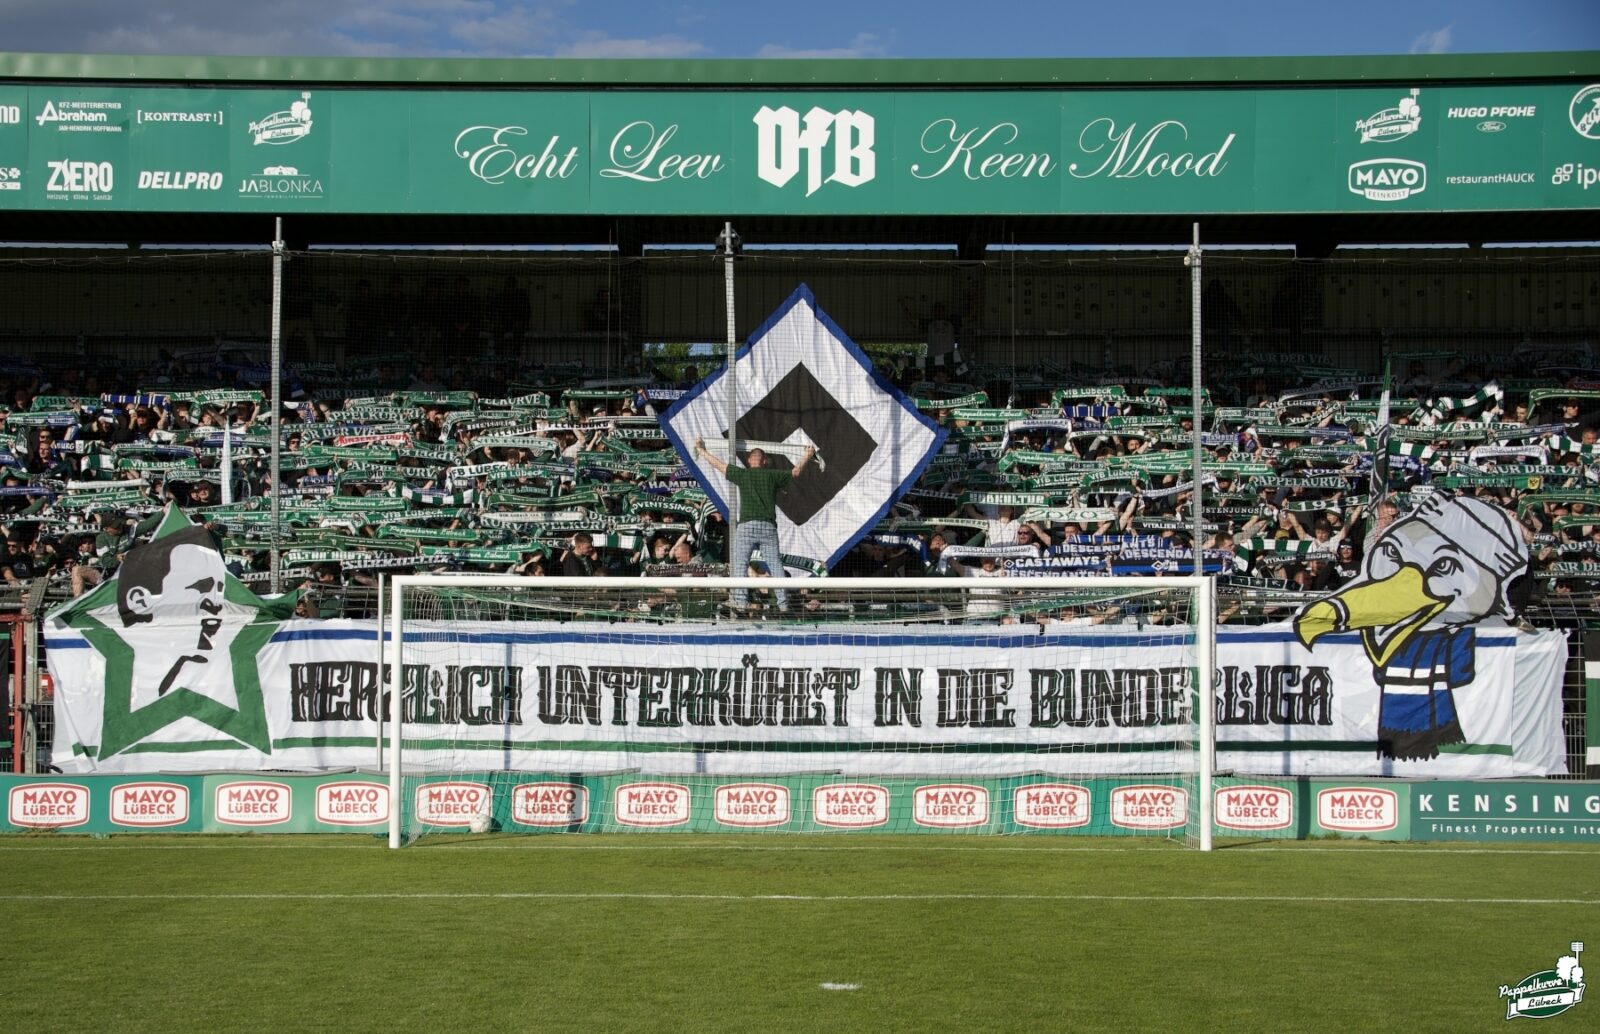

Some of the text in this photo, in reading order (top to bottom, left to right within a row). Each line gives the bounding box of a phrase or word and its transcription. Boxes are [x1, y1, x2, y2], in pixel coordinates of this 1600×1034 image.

[36, 100, 108, 126] Abraham
[1448, 106, 1536, 118] HUGO PFOHE
[454, 126, 578, 184] Echt
[753, 106, 876, 198] VfB
[911, 118, 1236, 180] Keen Mood
[47, 158, 113, 192] ZIERO
[138, 171, 222, 190] DELLPRO
[1356, 168, 1419, 186] MAYO
[1446, 173, 1535, 184] restaurantHAUCK
[1578, 164, 1600, 190] ip
[239, 180, 323, 192] JABLONKA
[1368, 190, 1406, 199] FEINKOST
[1140, 415, 1172, 423] Lübeck
[152, 459, 186, 467] Lübeck
[1524, 464, 1554, 474] DER
[490, 469, 543, 480] VfB Lübeck
[1089, 468, 1140, 480] VfB Lübeck
[650, 480, 700, 489] HAMBU
[1254, 476, 1346, 488] PAPPELKURVE
[382, 509, 442, 520] VfB Lübeck
[1015, 556, 1100, 568] CASTAWAYS
[290, 653, 1334, 728] HERZLICH UNTERKÜHLT IN DIE BUNDESLIGA
[23, 790, 77, 804] MAYO
[124, 790, 176, 803] MAYO
[228, 789, 279, 802] MAYO
[328, 789, 379, 802] MAYO
[428, 789, 479, 802] MAYO
[525, 790, 576, 803] MAYO
[628, 790, 678, 804] MAYO
[728, 790, 777, 804] MAYO
[826, 791, 876, 804] MAYO
[926, 791, 976, 805] MAYO
[1026, 792, 1078, 805] MAYO
[1123, 792, 1174, 806] MAYO
[1227, 793, 1279, 806] MAYO
[1331, 794, 1384, 808] MAYO
[23, 805, 76, 815] LÜBECK
[124, 804, 175, 814] LÜBECK
[227, 802, 278, 813] LÜBECK
[328, 802, 378, 813] LÜBECK
[428, 803, 479, 814] LÜBECK
[524, 804, 576, 814] LÜBECK
[628, 804, 677, 815] LÜBECK
[727, 804, 776, 815] LÜBECK
[826, 804, 876, 816] LÜBECK
[925, 805, 975, 816] LÜBECK
[1026, 805, 1076, 816] LÜBECK
[1122, 806, 1174, 817] LÜBECK
[1227, 806, 1278, 818] LÜBECK
[1331, 808, 1383, 820] LÜBECK
[1432, 824, 1477, 832] Finest
[1486, 824, 1565, 835] Properties
